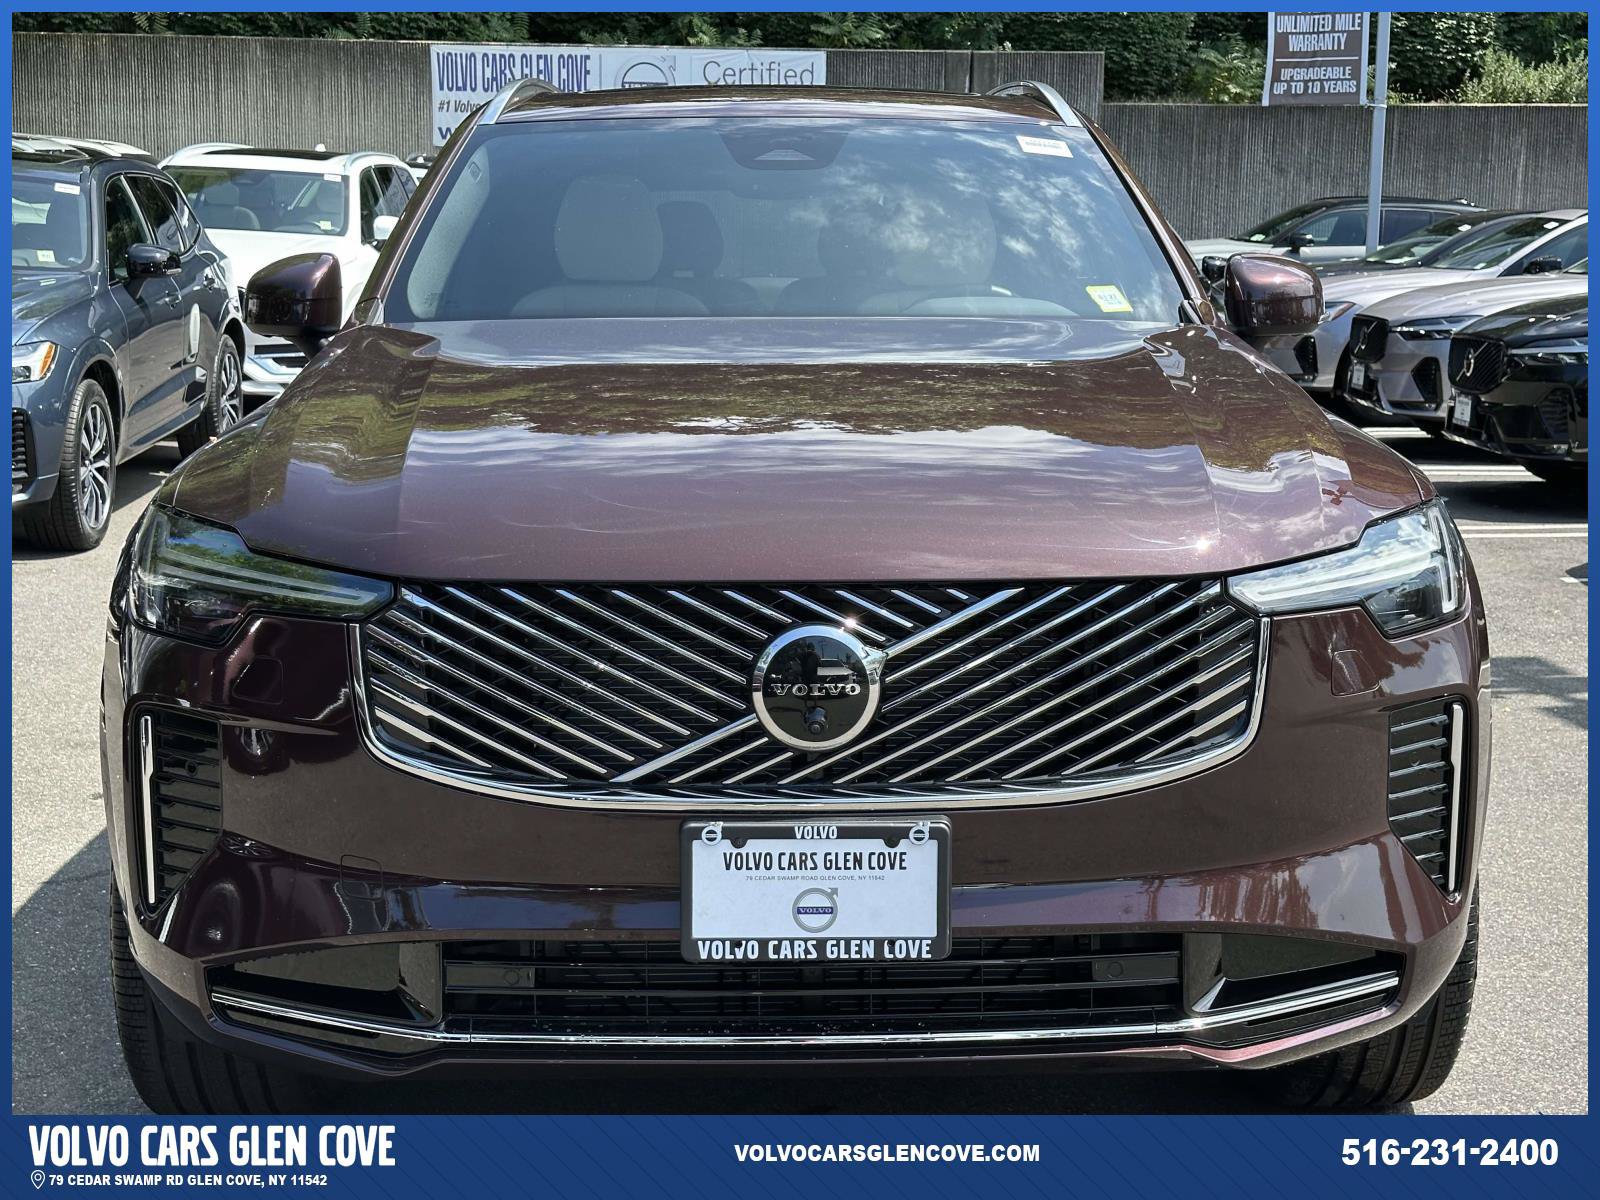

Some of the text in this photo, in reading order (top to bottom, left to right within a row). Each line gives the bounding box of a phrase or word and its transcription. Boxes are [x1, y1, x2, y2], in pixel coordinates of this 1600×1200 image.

[1277, 13, 1361, 33] UNLIMITED MILE
[1288, 33, 1347, 52] WARRANTY
[436, 52, 478, 93] VOLVO
[482, 52, 516, 93] CARS
[557, 54, 591, 93] COVE
[703, 60, 814, 85] Certified
[1281, 67, 1352, 80] UPGRADEABLE
[1274, 80, 1357, 95] UP TO 10 YEARS
[438, 100, 450, 112] #1
[770, 683, 861, 696] VOLVO
[794, 825, 838, 840] VOLVO
[723, 851, 907, 871] VOLVO CARS GLEN COVE
[698, 940, 932, 960] VOLVO CARS GLEN COVE
